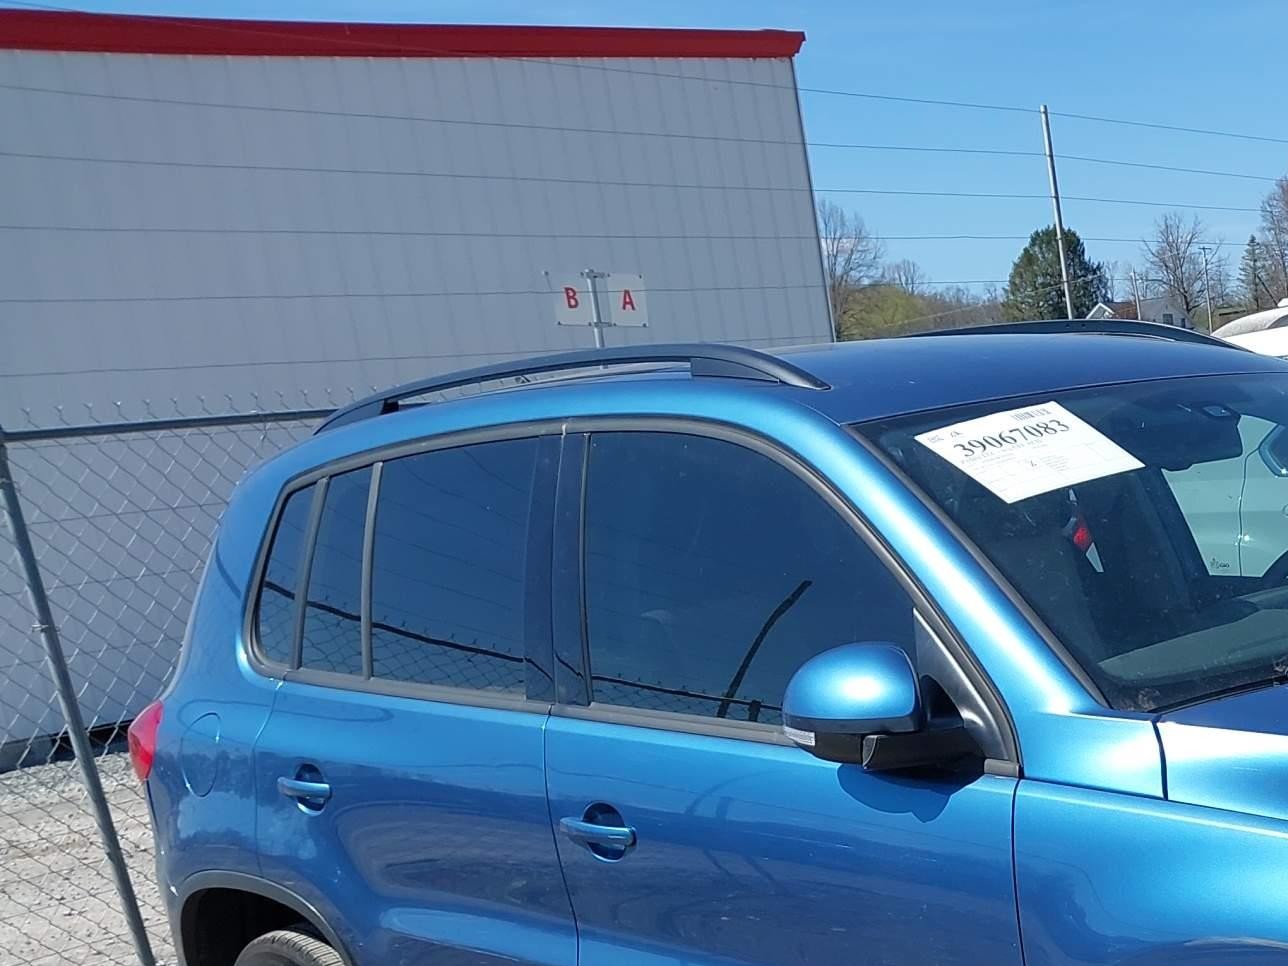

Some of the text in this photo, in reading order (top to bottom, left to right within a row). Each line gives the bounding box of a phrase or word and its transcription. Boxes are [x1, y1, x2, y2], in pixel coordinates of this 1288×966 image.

[563, 286, 580, 309] B
[621, 288, 637, 311] A
[953, 418, 1070, 458] 39067083
